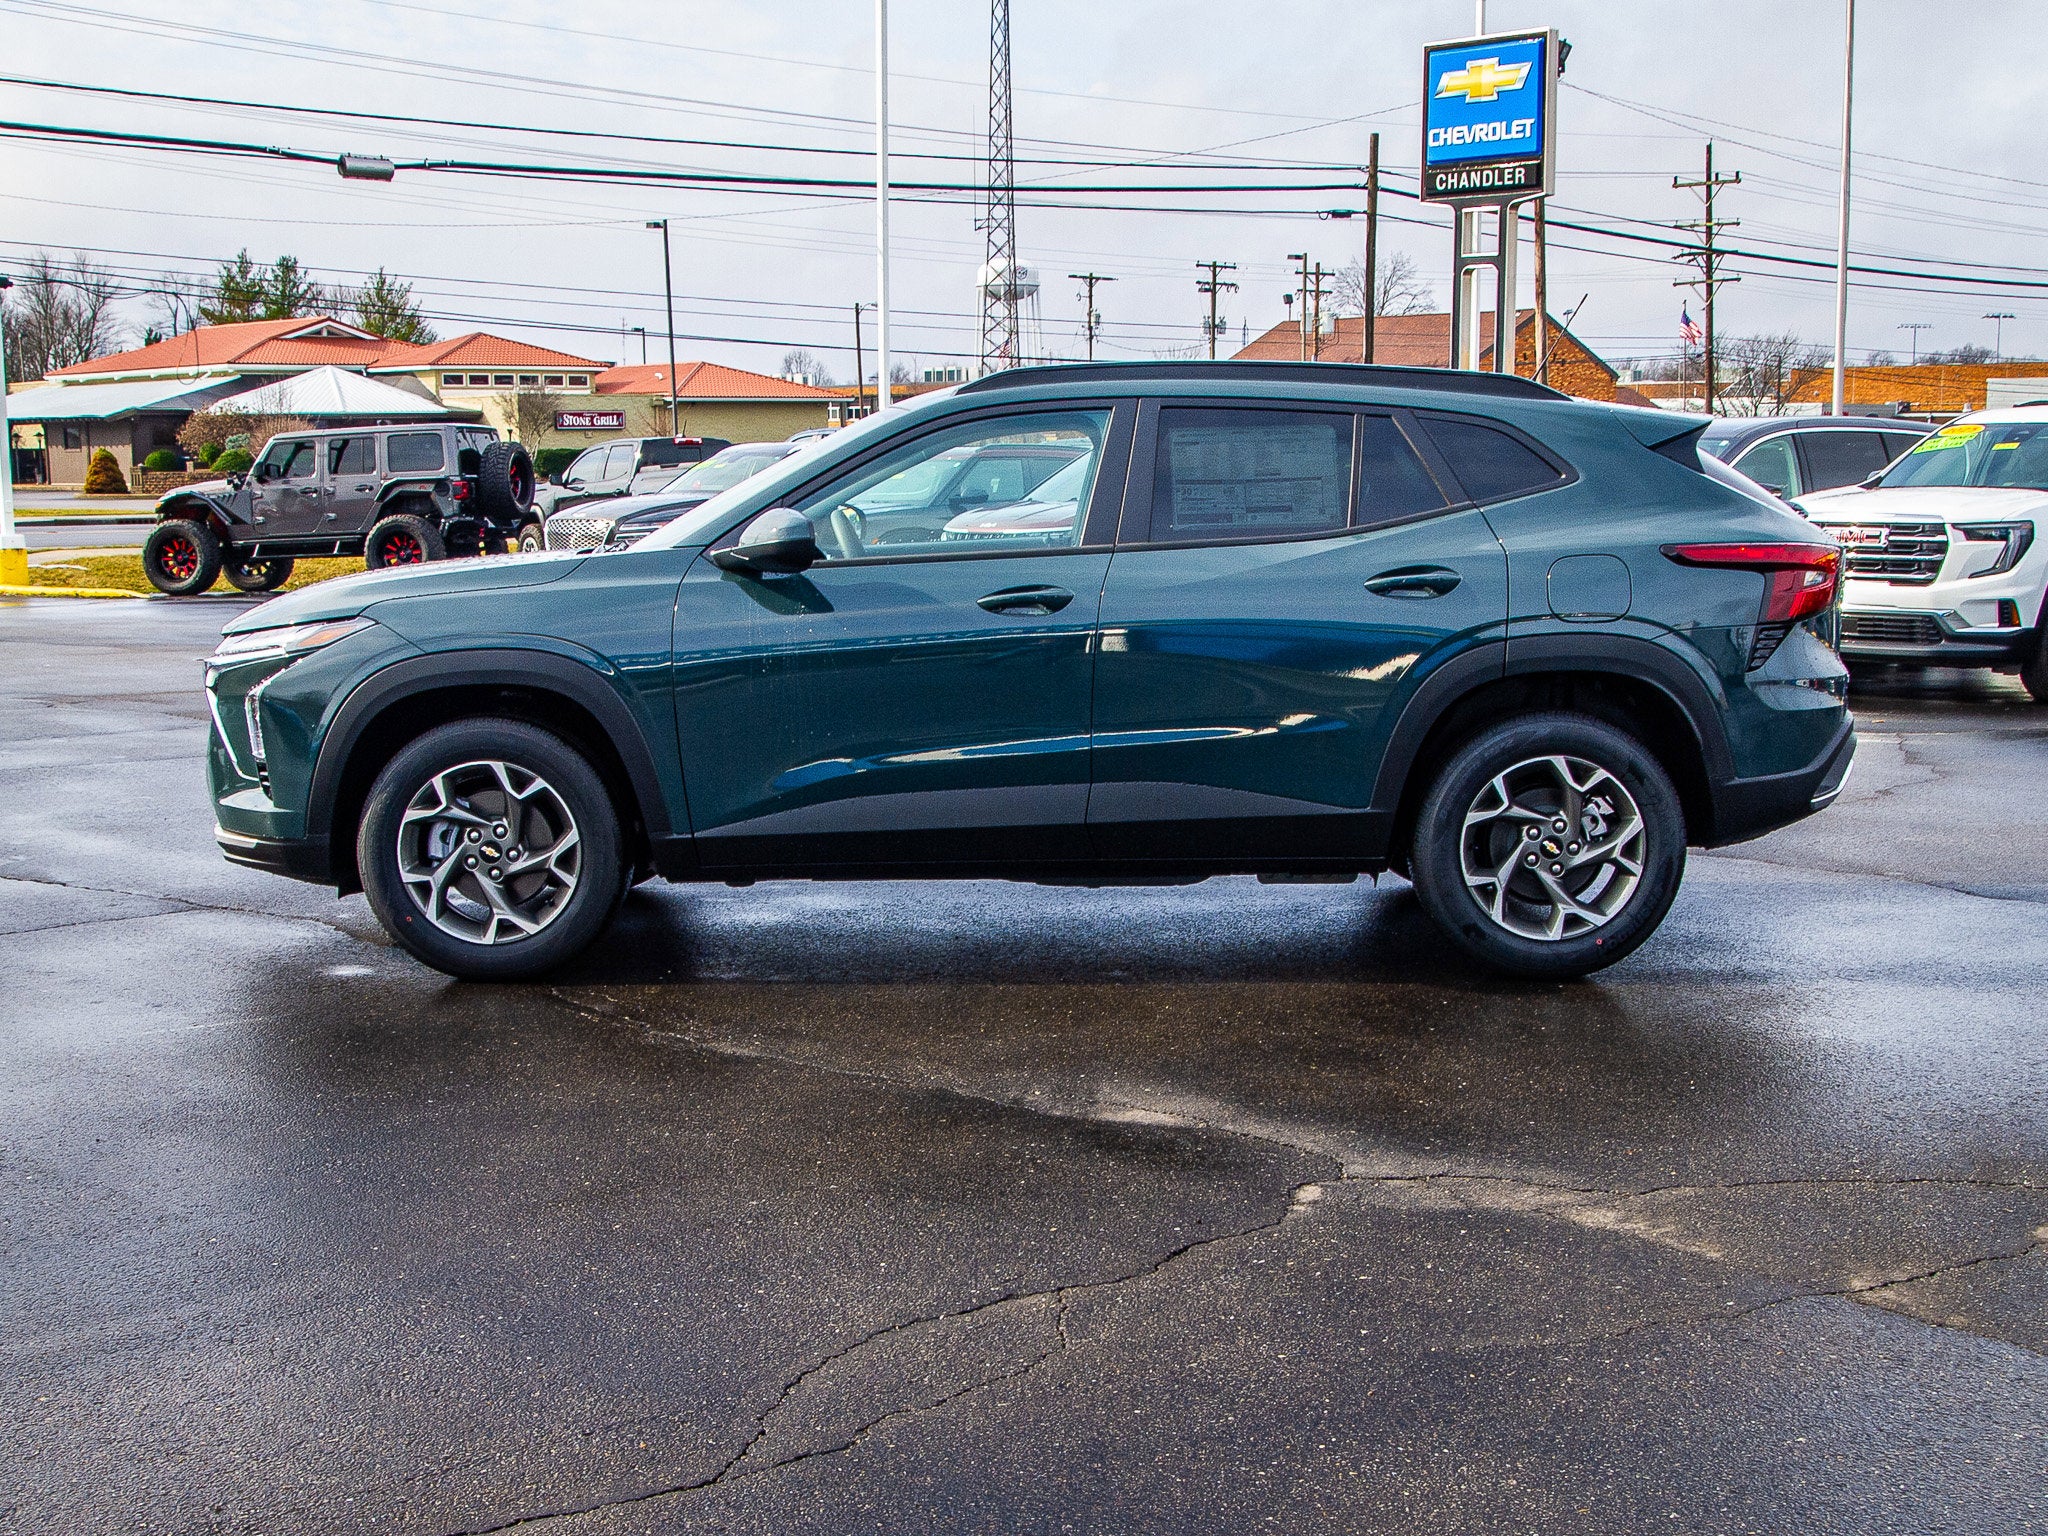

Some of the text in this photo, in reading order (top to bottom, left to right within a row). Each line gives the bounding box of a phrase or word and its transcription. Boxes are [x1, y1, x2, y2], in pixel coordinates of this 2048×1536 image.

[1428, 118, 1535, 147] CHEVROLET
[1435, 167, 1525, 190] CHANDLER
[563, 413, 592, 426] STONE
[593, 414, 619, 426] GRILL
